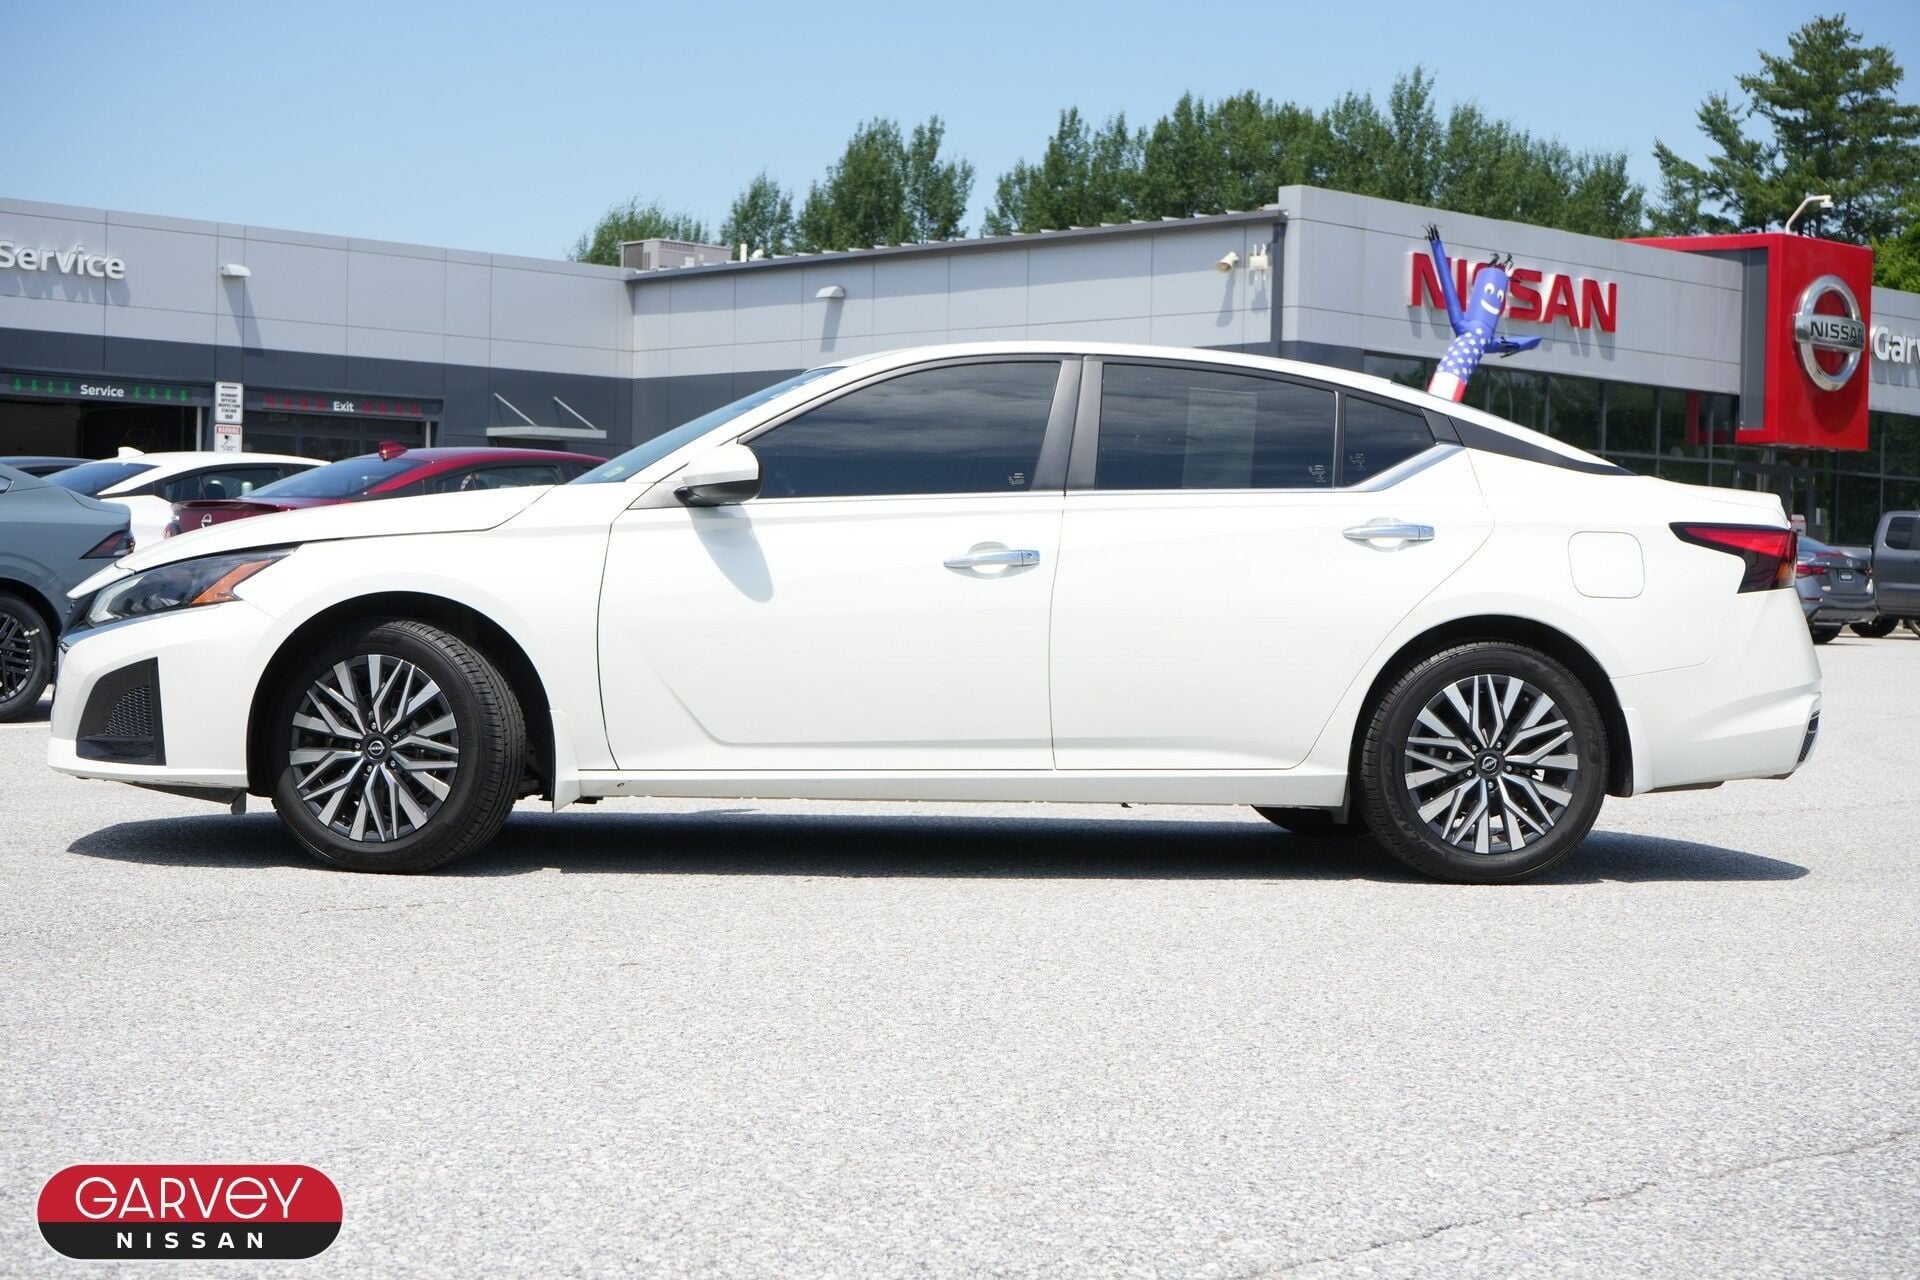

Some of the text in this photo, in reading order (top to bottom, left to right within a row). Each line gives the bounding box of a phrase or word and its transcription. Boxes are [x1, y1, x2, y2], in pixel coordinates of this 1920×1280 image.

[0, 240, 126, 279] Service
[1411, 252, 1617, 333] NISAN
[80, 384, 124, 397] Service
[333, 401, 354, 412] Exit
